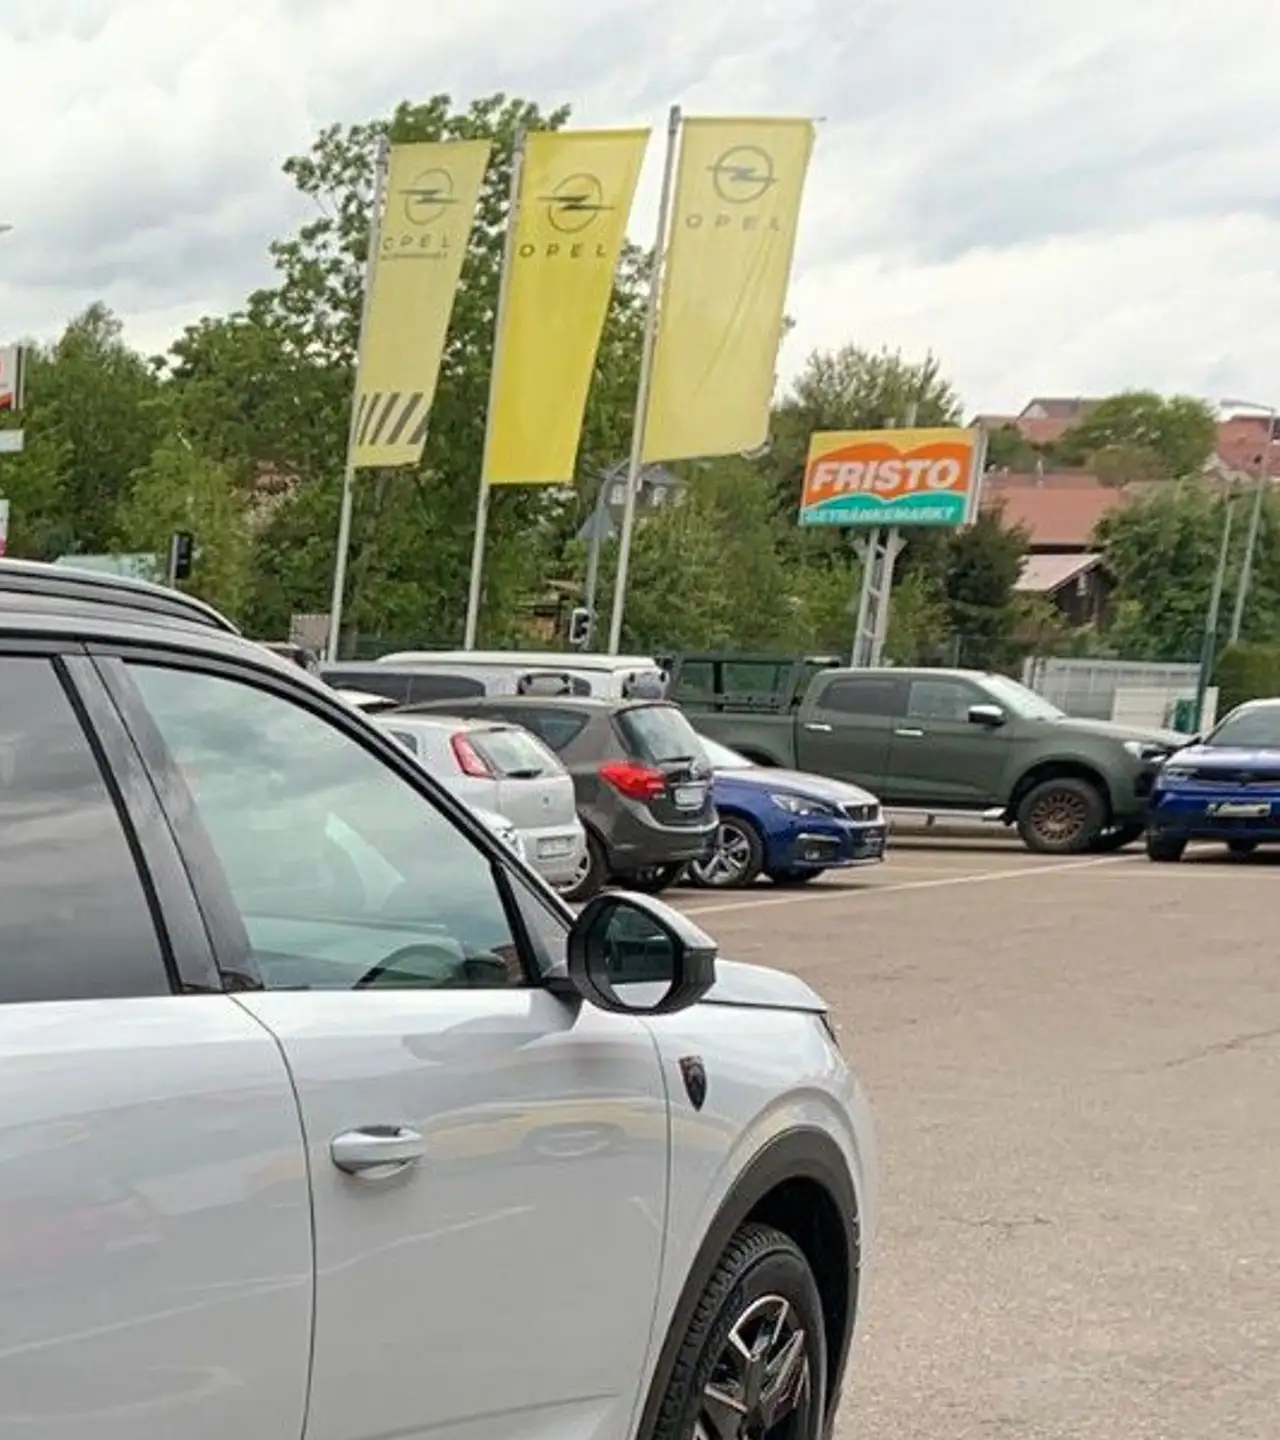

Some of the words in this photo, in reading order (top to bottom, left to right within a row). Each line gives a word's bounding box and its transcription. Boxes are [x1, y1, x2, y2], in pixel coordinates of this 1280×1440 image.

[684, 213, 782, 232] OPEL
[518, 243, 608, 260] OPEL
[809, 457, 961, 493] FRISTO
